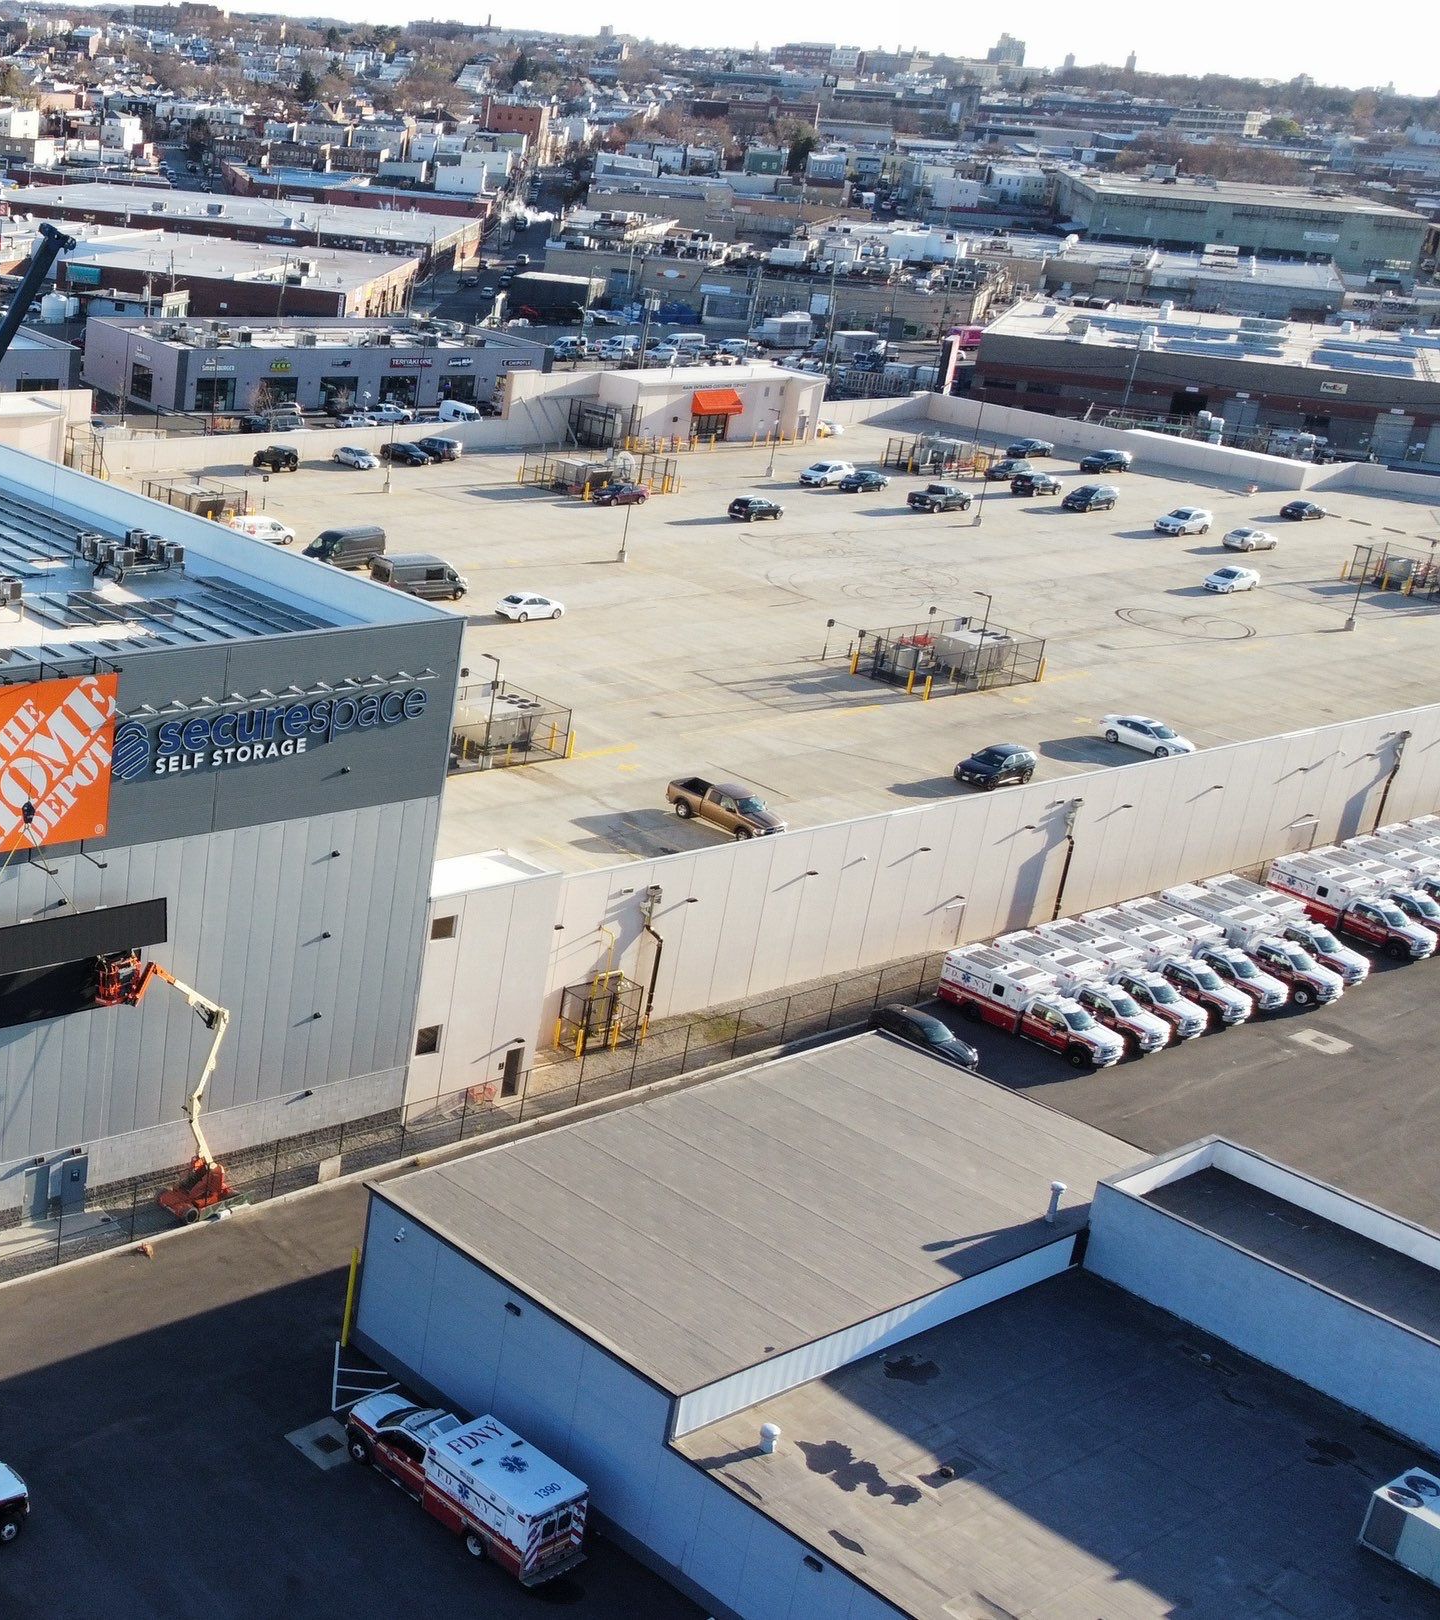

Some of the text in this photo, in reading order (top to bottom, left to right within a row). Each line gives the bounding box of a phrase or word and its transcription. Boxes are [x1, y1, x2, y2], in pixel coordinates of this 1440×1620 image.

[156, 686, 428, 756] securespace
[154, 737, 308, 776] SELF STORAGE
[18, 735, 112, 847] DEPOT
[446, 1419, 505, 1456] FDNY
[533, 1481, 563, 1500] 1390
